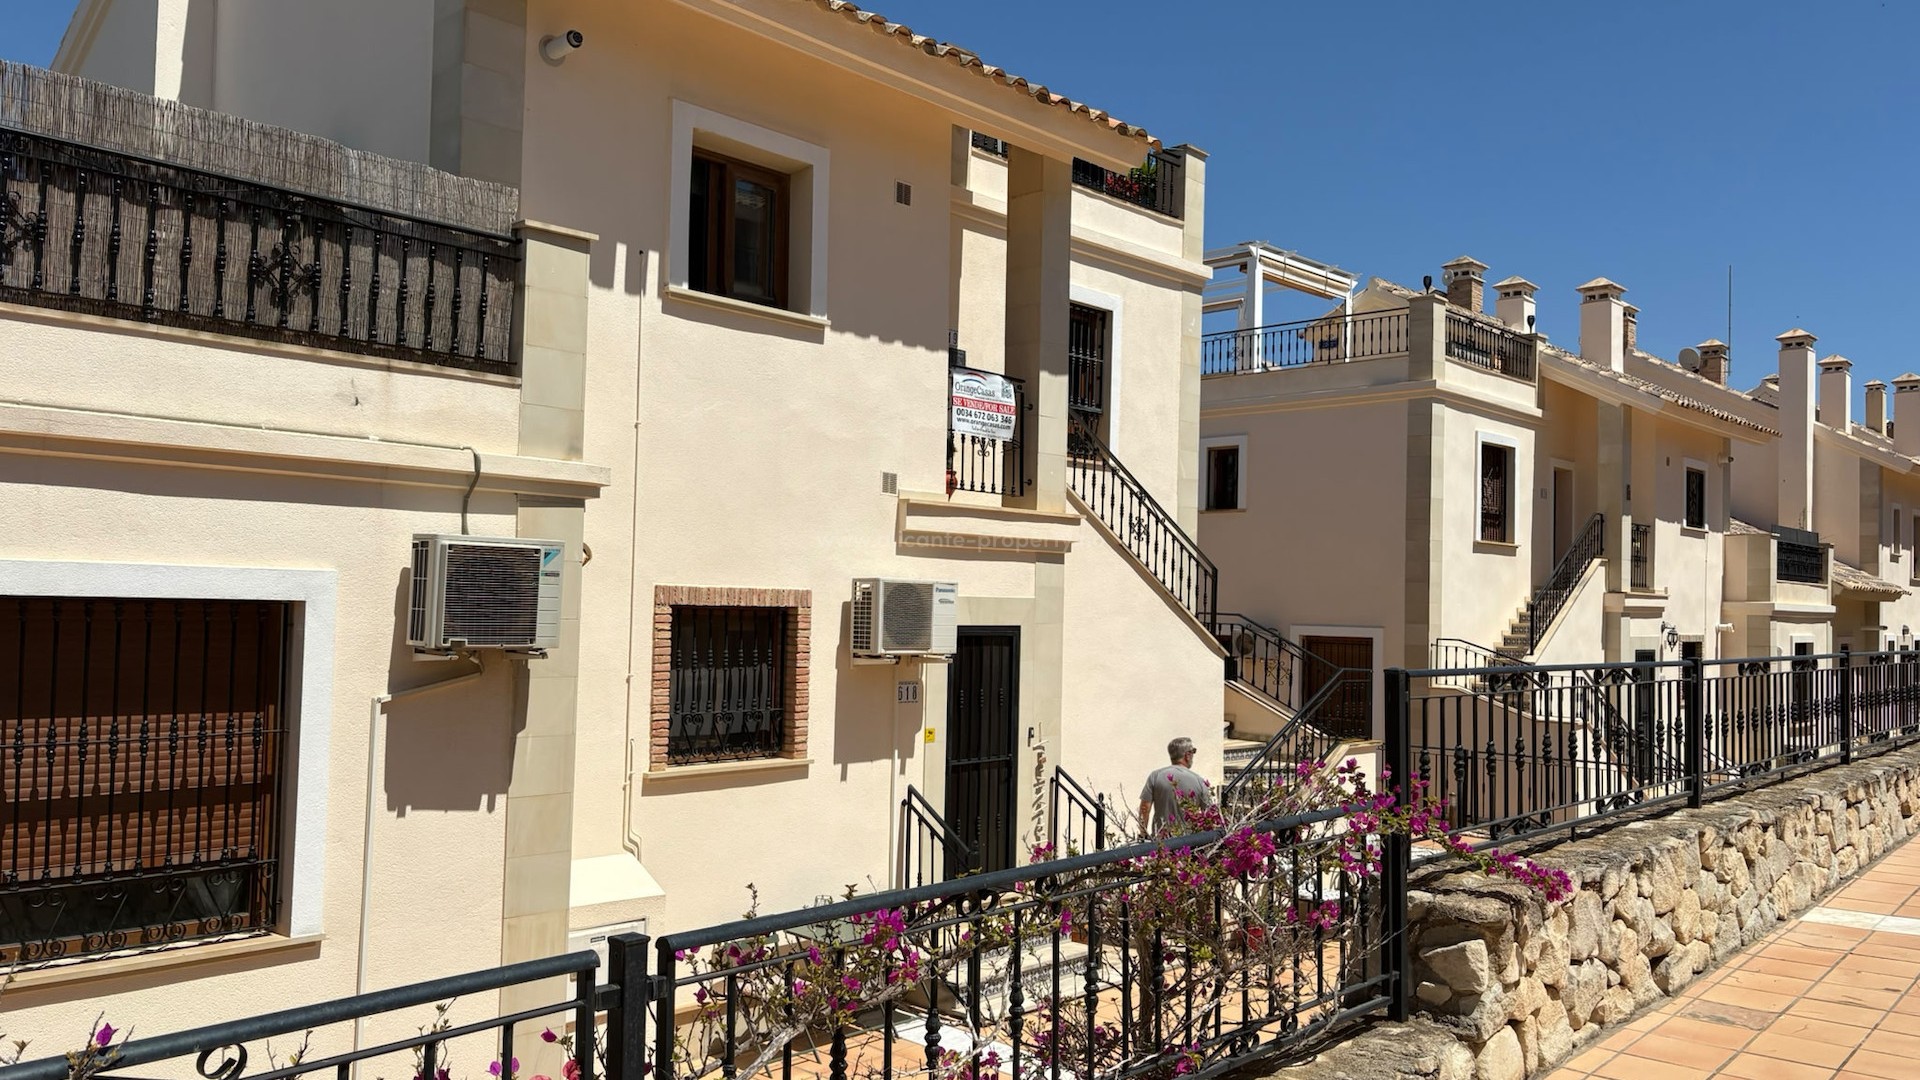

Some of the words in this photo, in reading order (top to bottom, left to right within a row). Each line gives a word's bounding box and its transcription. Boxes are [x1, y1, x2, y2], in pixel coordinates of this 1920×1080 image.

[954, 381, 996, 397] OrangeCasas
[953, 397, 963, 406] SE
[963, 398, 999, 412] VENDE/FOR
[999, 404, 1015, 415] SALE
[956, 407, 973, 418] 0034
[974, 410, 986, 420] 672
[987, 413, 999, 422] 063
[1000, 414, 1012, 425] 346
[956, 417, 1011, 430] www.orangecasas.com
